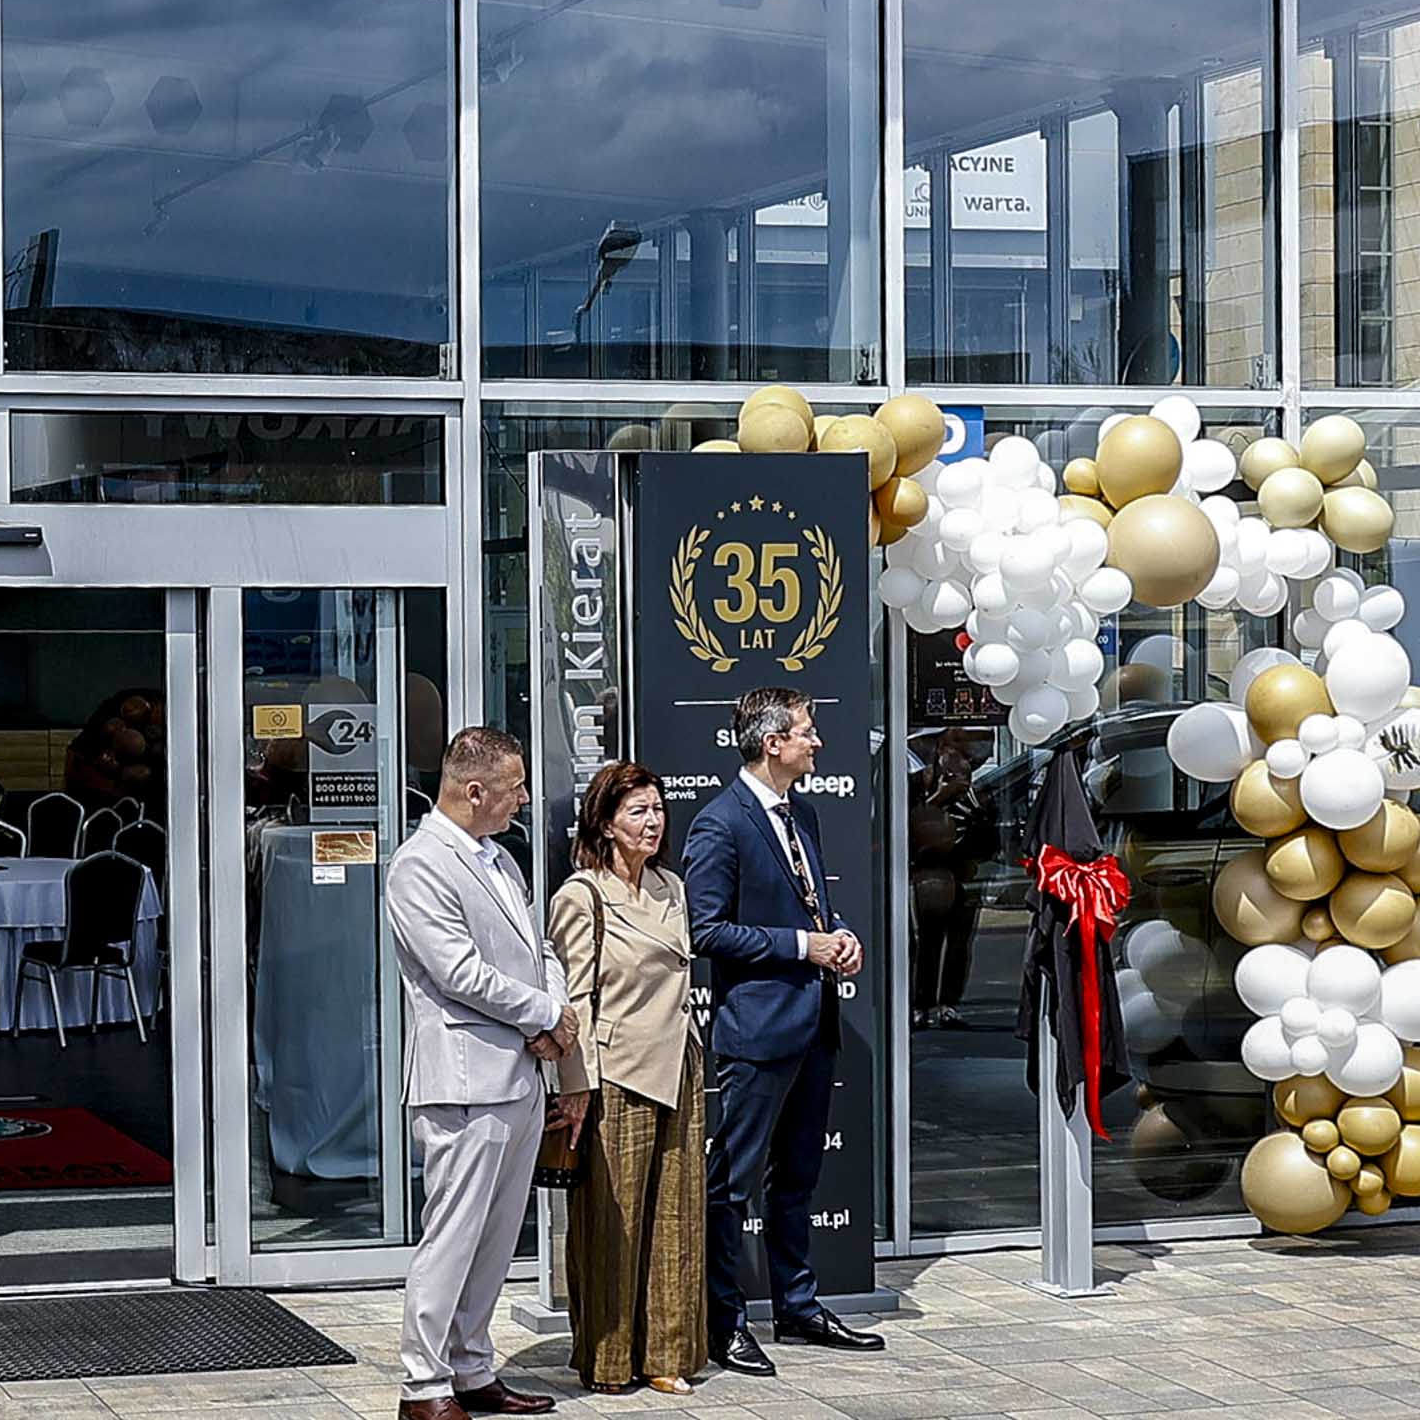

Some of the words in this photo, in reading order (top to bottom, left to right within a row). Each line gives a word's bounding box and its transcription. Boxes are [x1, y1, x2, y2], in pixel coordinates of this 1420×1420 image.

[713, 542, 801, 623] 35
[560, 512, 604, 680] Kierat
[740, 628, 776, 649] LAT
[338, 721, 372, 743] 24
[794, 773, 855, 797] Jeep
